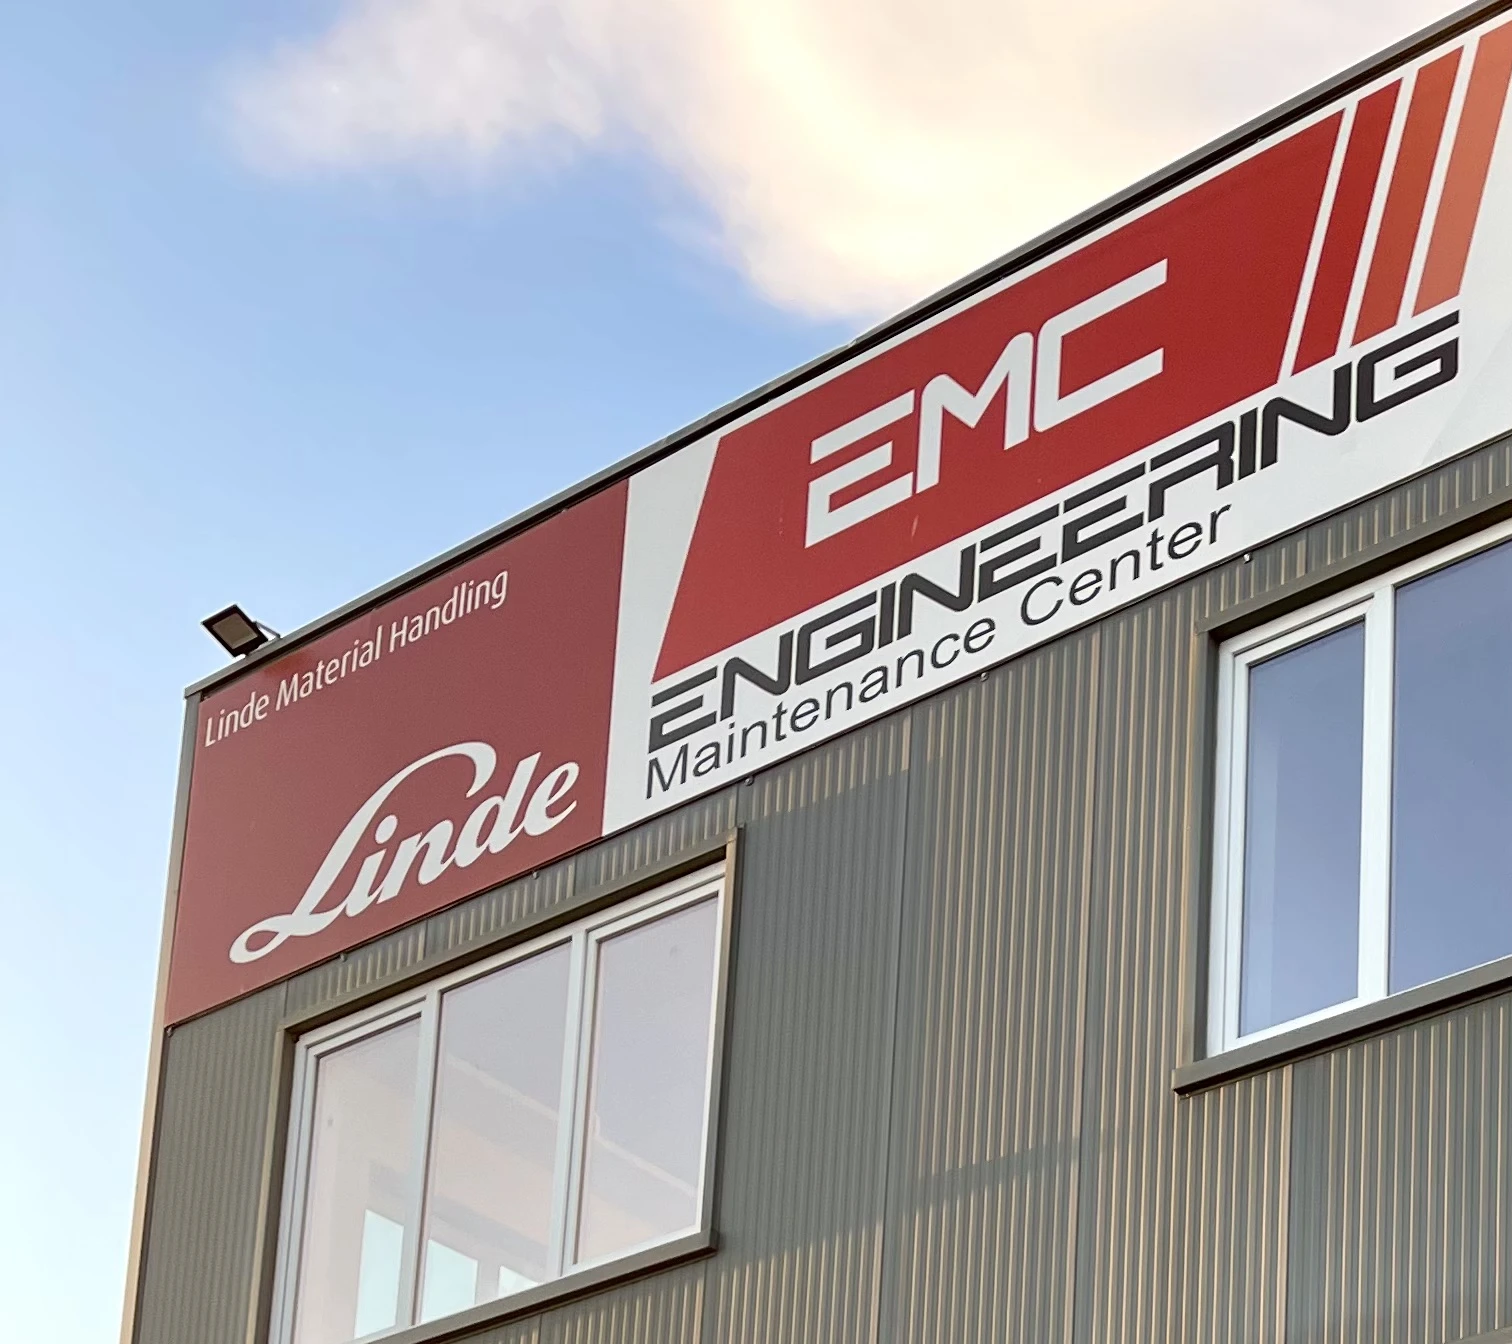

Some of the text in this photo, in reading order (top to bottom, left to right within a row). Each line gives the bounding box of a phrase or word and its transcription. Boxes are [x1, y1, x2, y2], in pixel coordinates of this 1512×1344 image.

[649, 310, 1459, 754] ENGINEERING
[805, 258, 1168, 548] EMC
[205, 570, 509, 747] Linde Material Handling
[646, 501, 1233, 799] Maintenance Center
[229, 741, 580, 964] Linde
